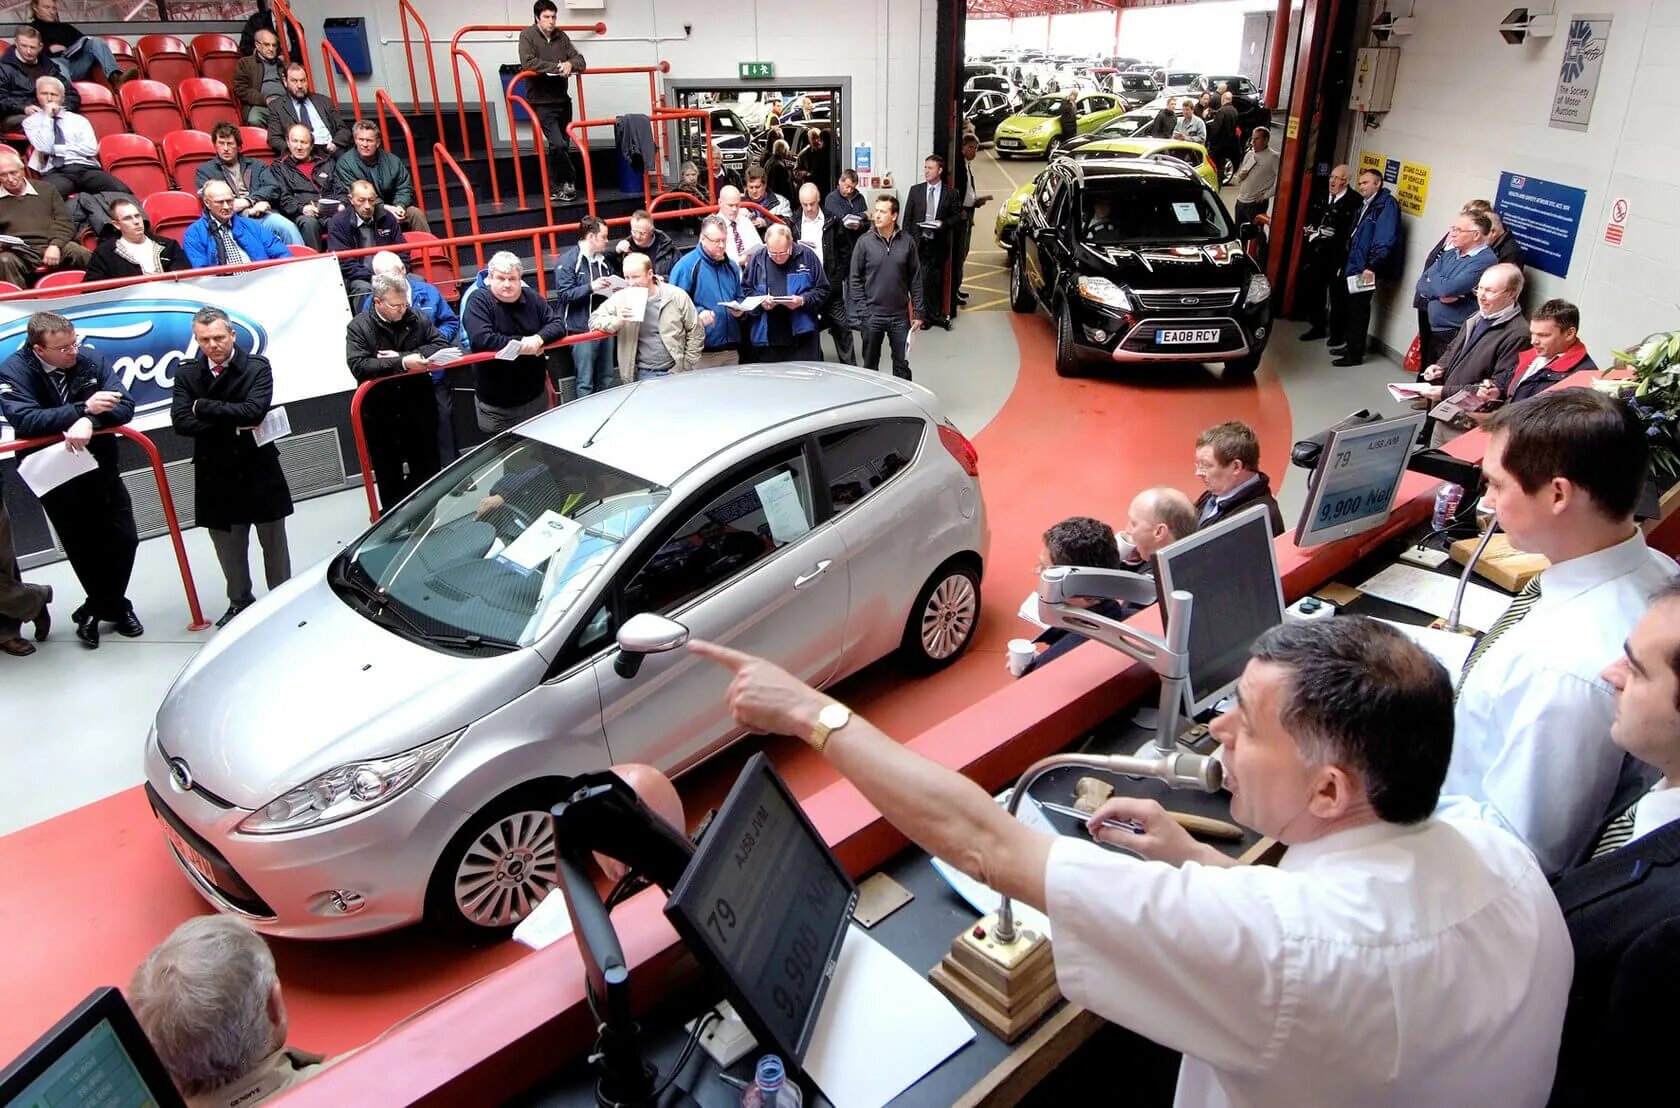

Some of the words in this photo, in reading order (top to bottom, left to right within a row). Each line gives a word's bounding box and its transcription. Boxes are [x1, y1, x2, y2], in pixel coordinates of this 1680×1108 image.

[1570, 86, 1589, 98] Society
[1164, 332, 1193, 342] EA08
[1196, 330, 1218, 341] RCY
[1334, 450, 1352, 469] 79
[752, 805, 769, 838] JVM
[707, 898, 737, 944] 79
